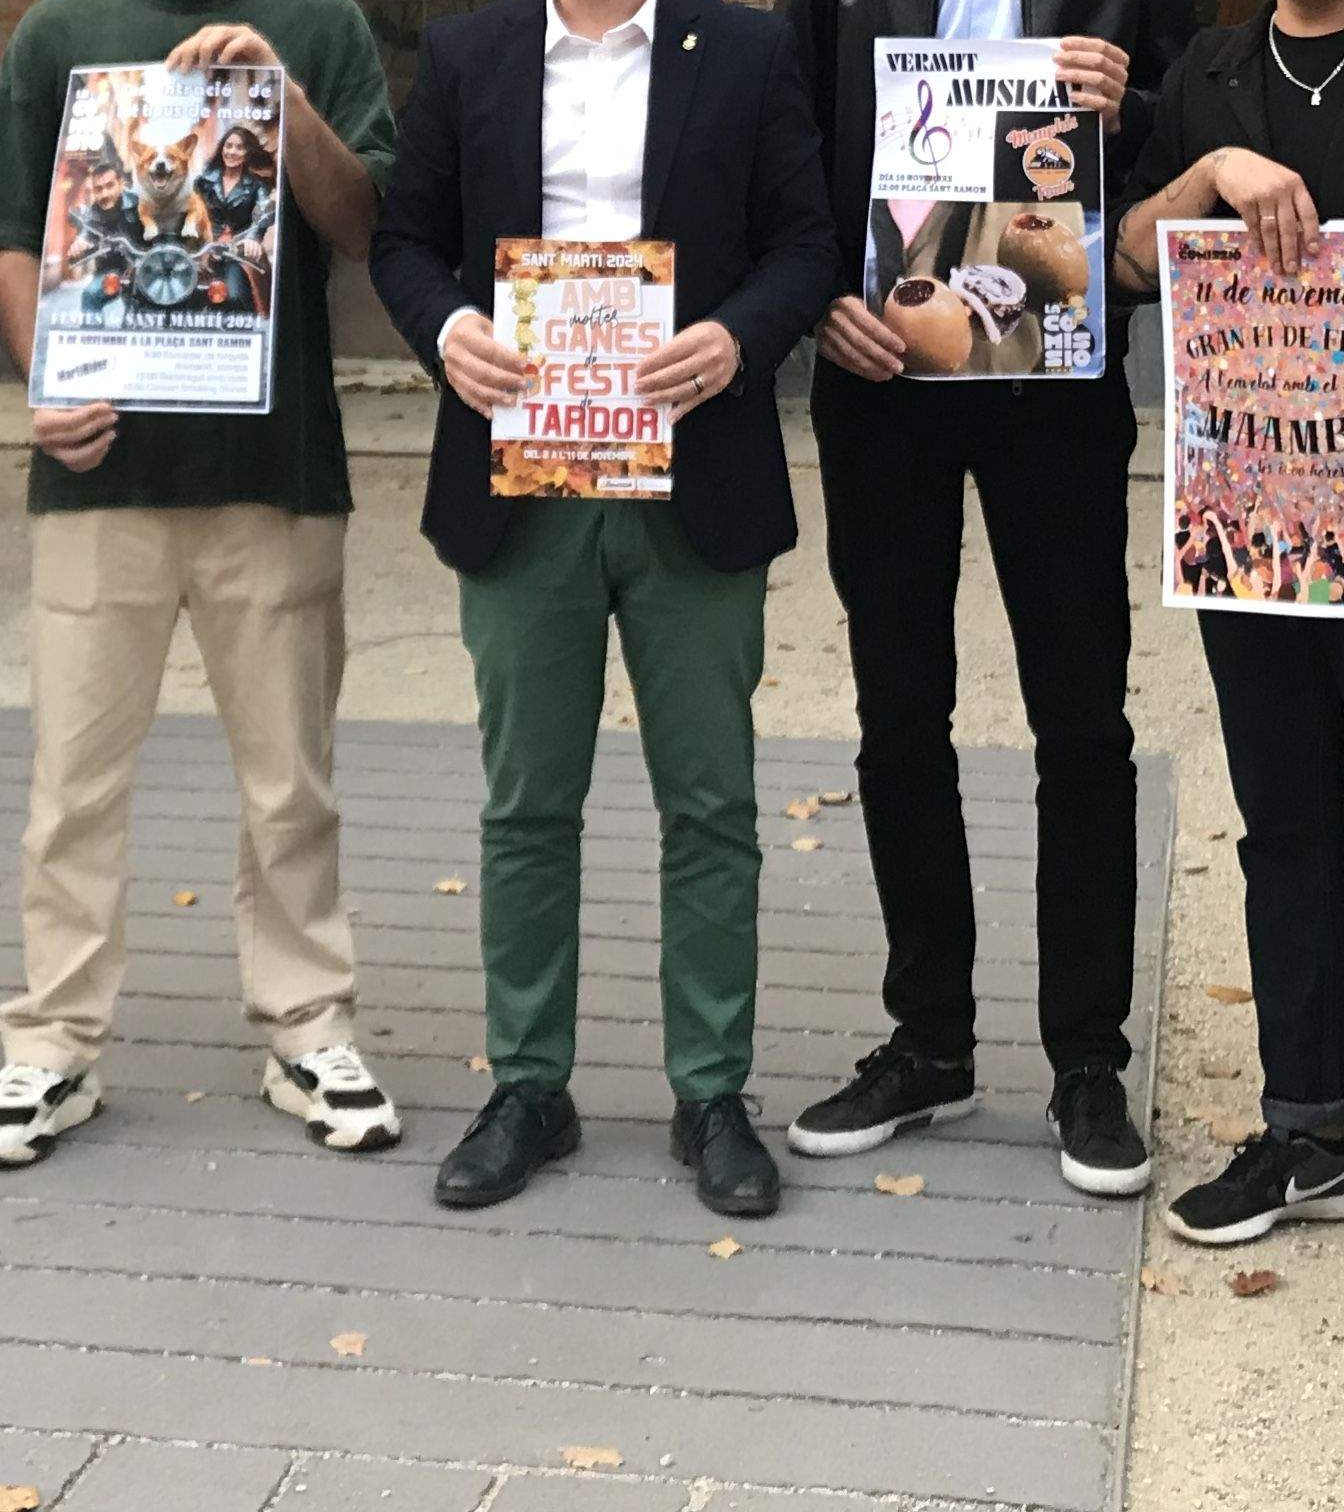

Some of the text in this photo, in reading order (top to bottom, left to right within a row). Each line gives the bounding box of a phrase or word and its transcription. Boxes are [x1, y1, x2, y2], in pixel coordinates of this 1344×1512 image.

[886, 52, 978, 73] VERMUT
[248, 82, 273, 99] de
[217, 105, 272, 120] motos
[954, 186, 987, 194] RAMON
[522, 252, 556, 267] SANT
[606, 253, 644, 268] 2024
[560, 281, 637, 313] AMB
[1196, 282, 1213, 303] 11
[1223, 273, 1252, 306] de
[125, 312, 167, 328] SANT
[140, 336, 152, 346] LA
[155, 336, 186, 349] PLAÇA
[190, 337, 214, 348] SANT
[545, 319, 660, 355] GANES
[1186, 327, 1244, 359] GRAN
[1253, 325, 1273, 348] FI
[1283, 326, 1312, 349] DE
[544, 363, 639, 396] FEST
[1199, 369, 1210, 392] A
[1283, 374, 1318, 392] amb
[1323, 371, 1338, 392] el
[522, 403, 659, 441] TARDOR
[523, 449, 541, 459] DEL
